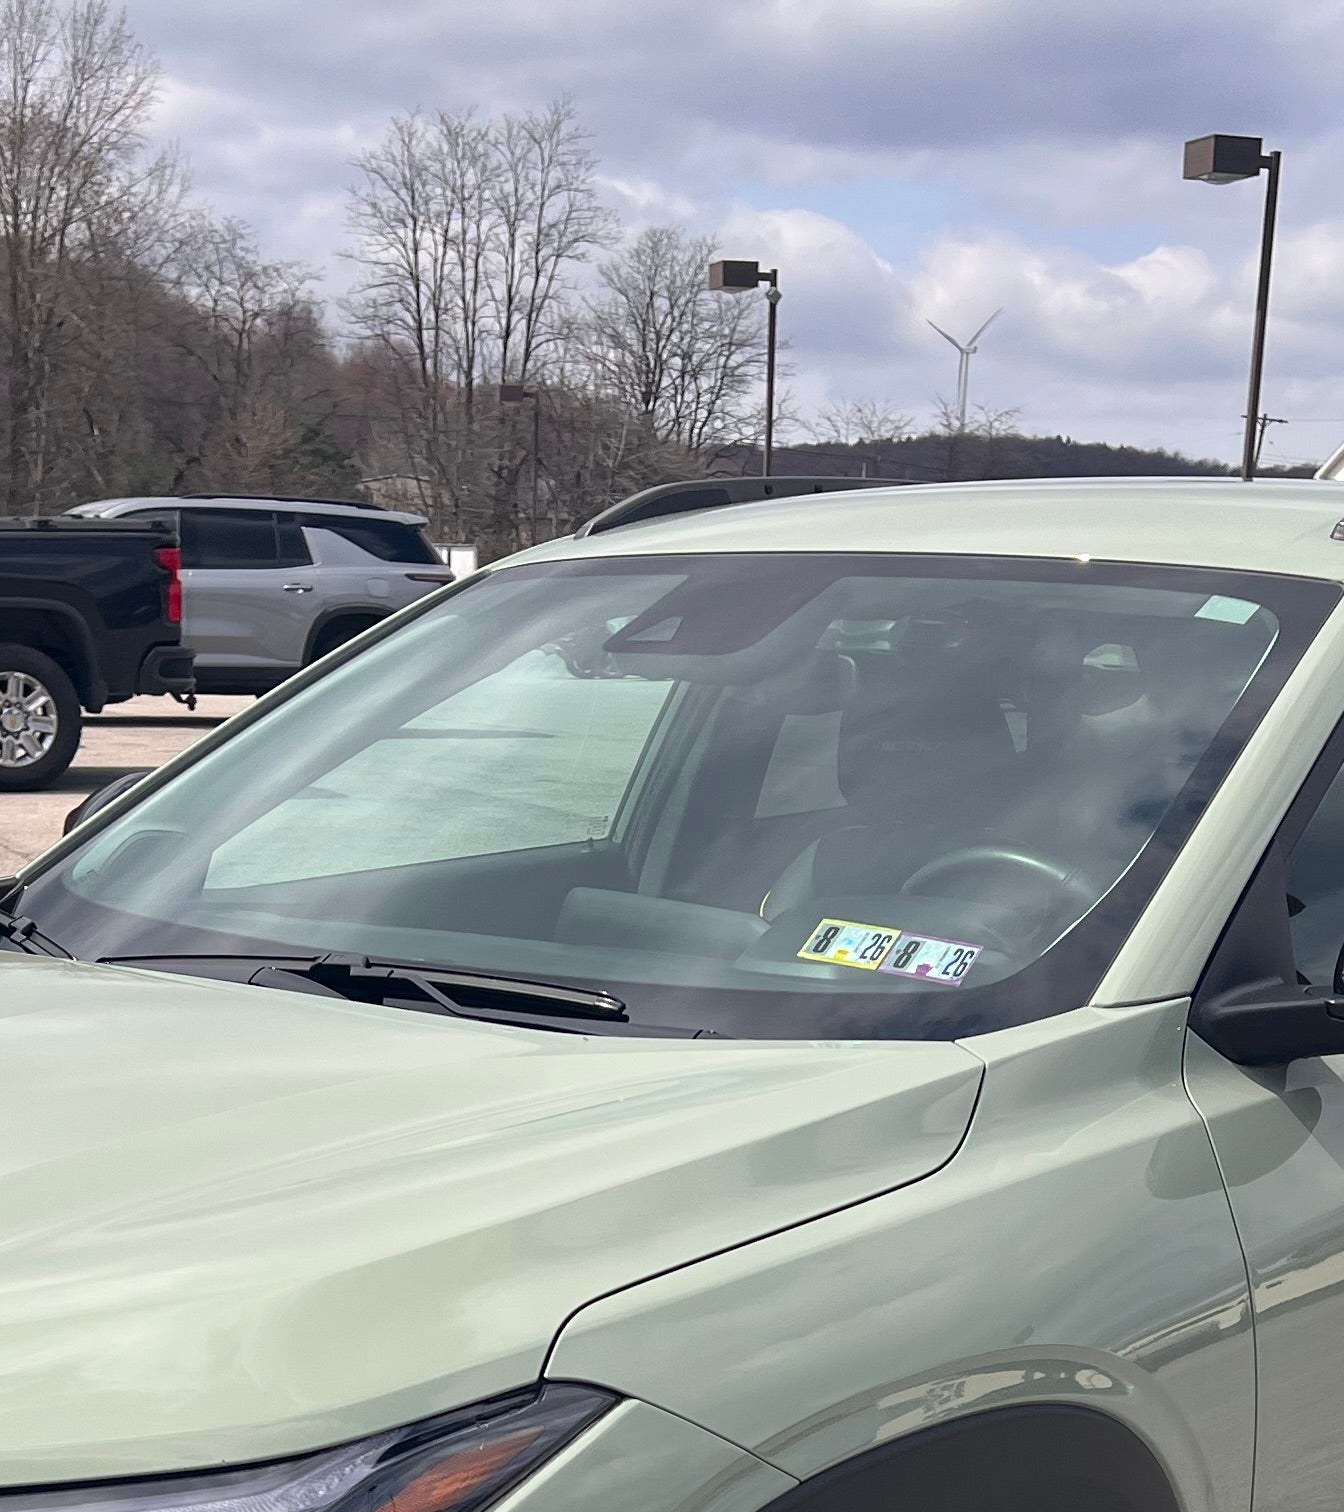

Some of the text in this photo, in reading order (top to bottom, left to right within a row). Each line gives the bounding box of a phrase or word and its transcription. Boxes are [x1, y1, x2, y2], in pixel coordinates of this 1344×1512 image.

[812, 926, 893, 961] 8 26
[893, 940, 975, 977] 8 26
